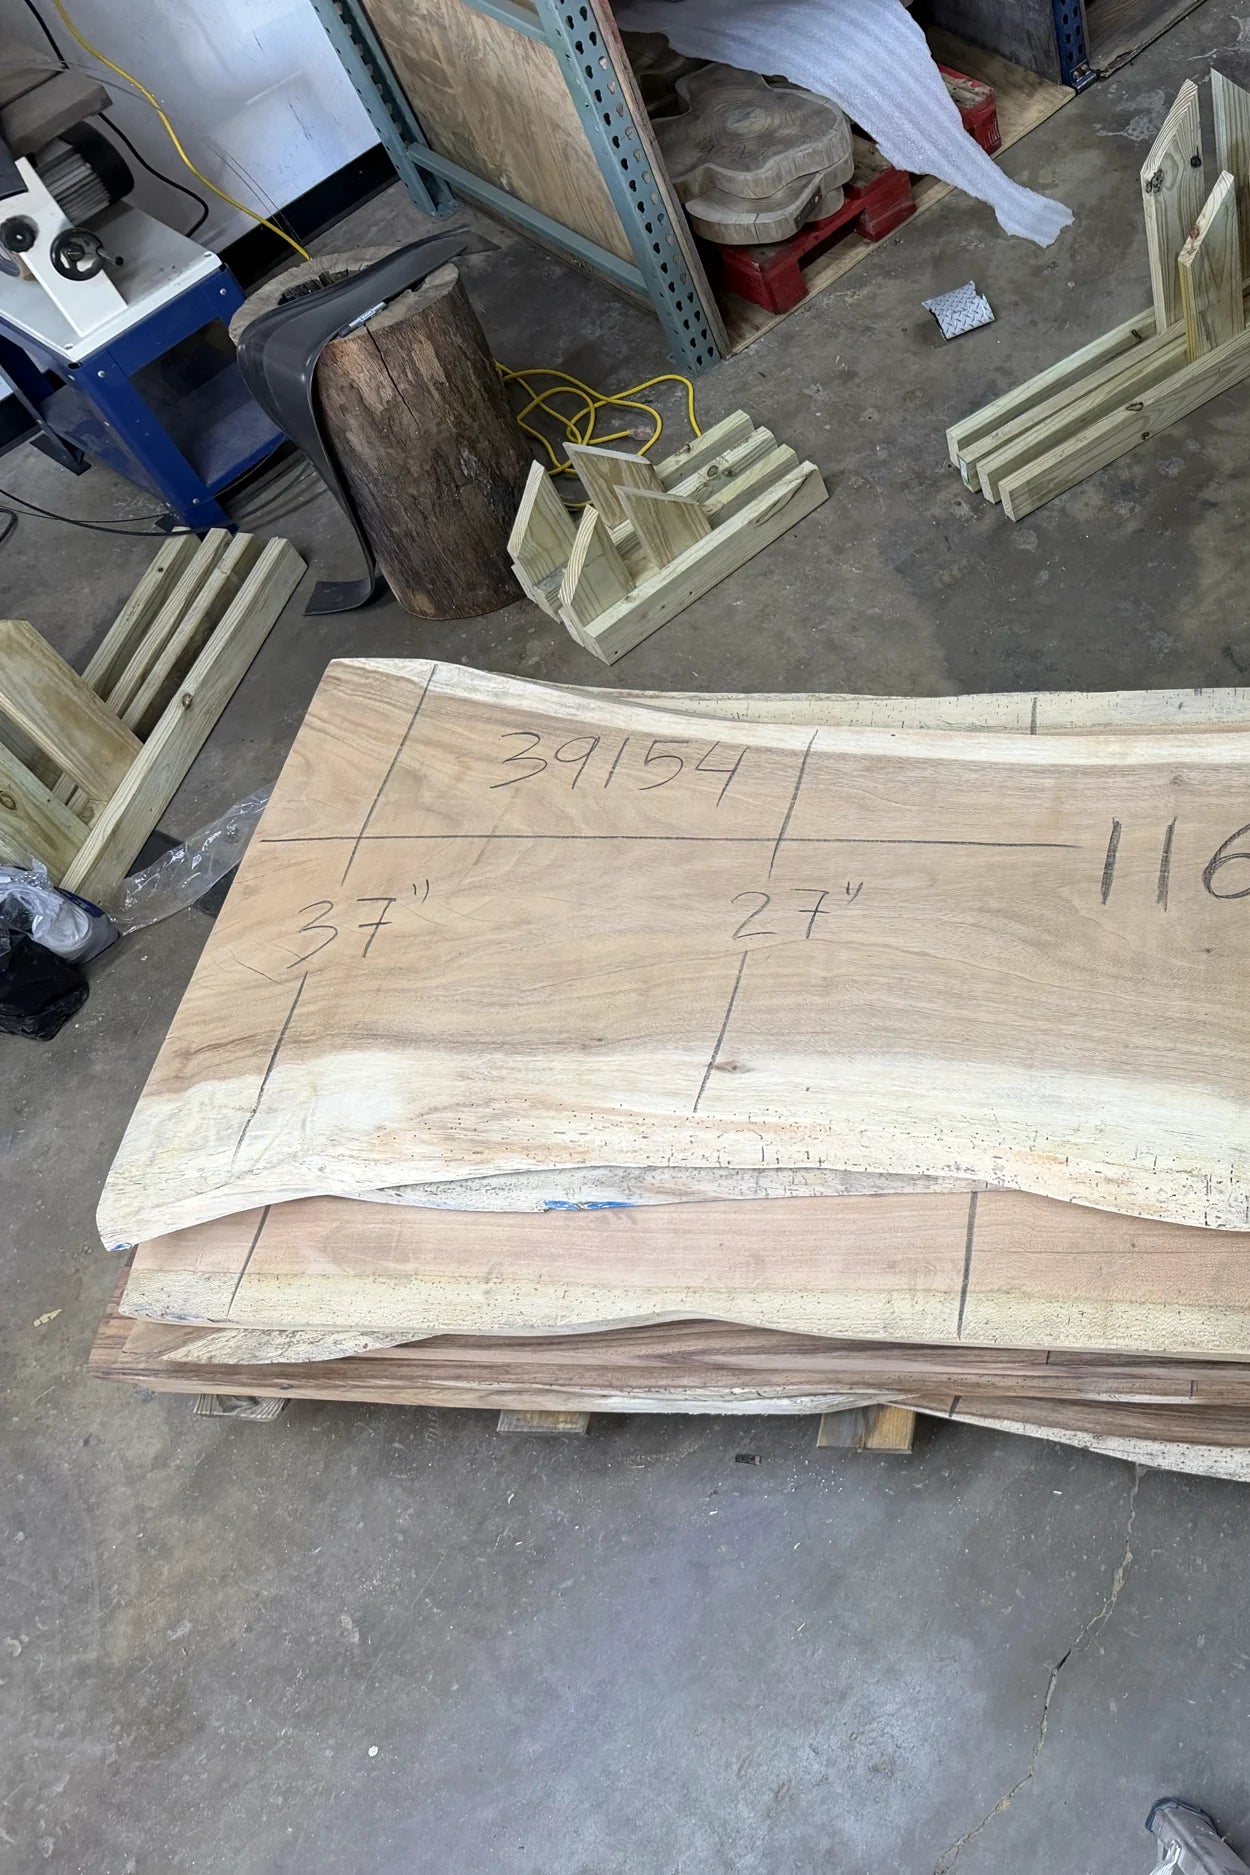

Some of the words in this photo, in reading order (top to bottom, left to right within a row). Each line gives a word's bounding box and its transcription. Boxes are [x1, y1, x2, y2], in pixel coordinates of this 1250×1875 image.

[489, 731, 750, 808] 39154
[286, 879, 430, 970] 37"
[731, 881, 864, 939] 27"
